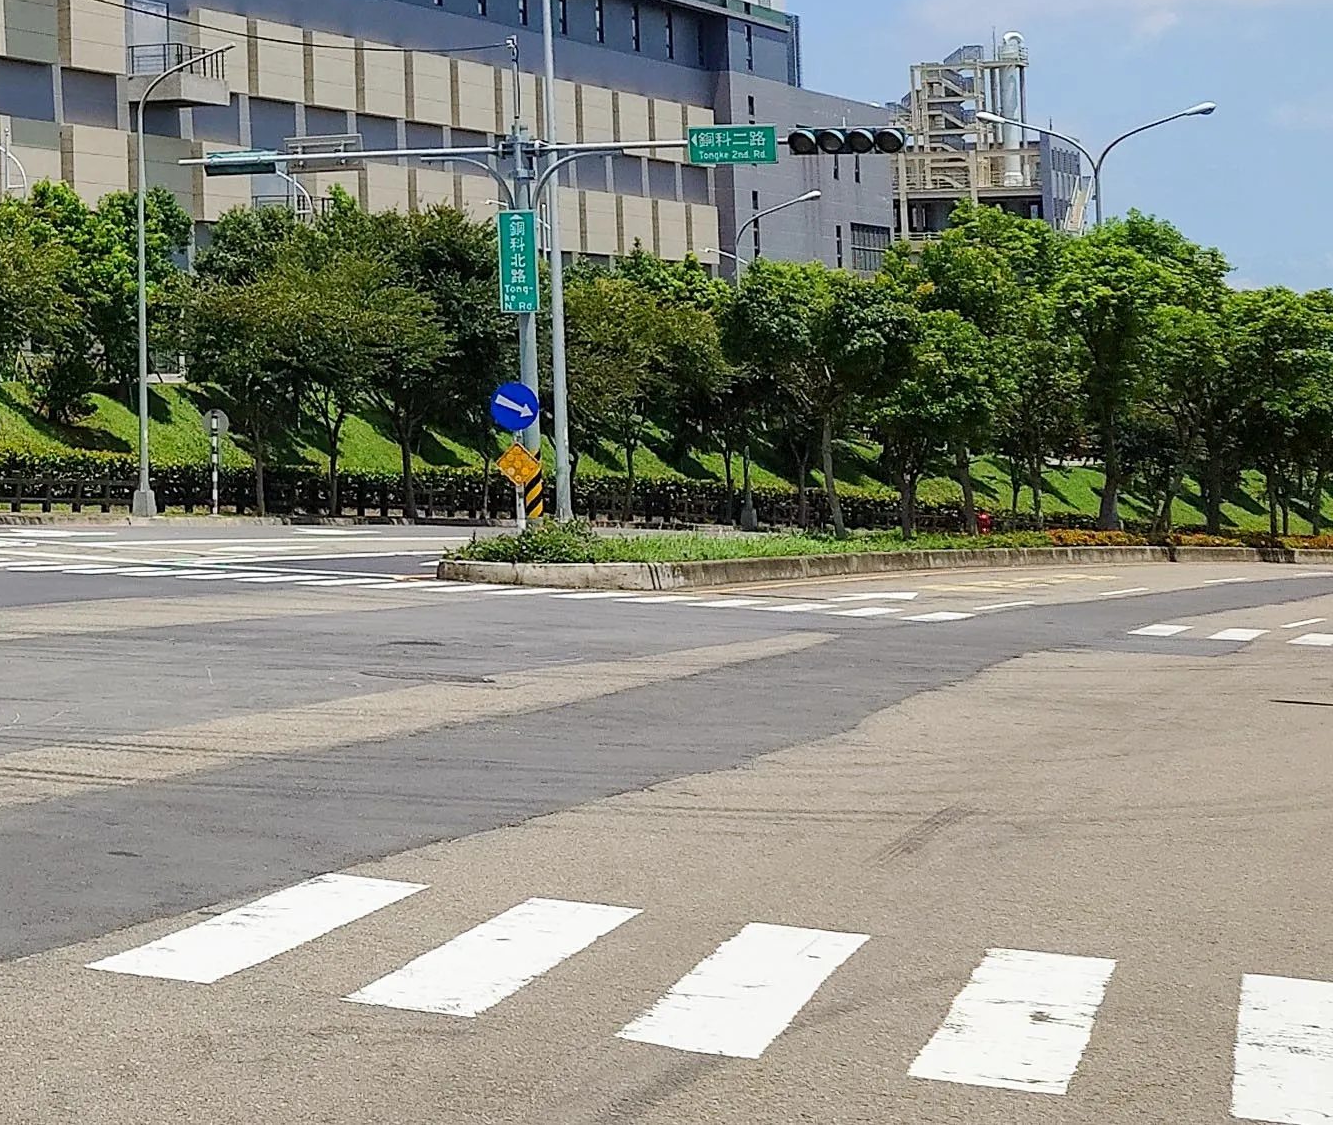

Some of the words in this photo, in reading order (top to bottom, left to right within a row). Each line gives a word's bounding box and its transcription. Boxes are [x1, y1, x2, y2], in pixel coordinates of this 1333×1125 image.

[698, 130, 766, 148] 銅科二路
[698, 150, 730, 162] Tongke
[509, 221, 526, 283] 銅科北路
